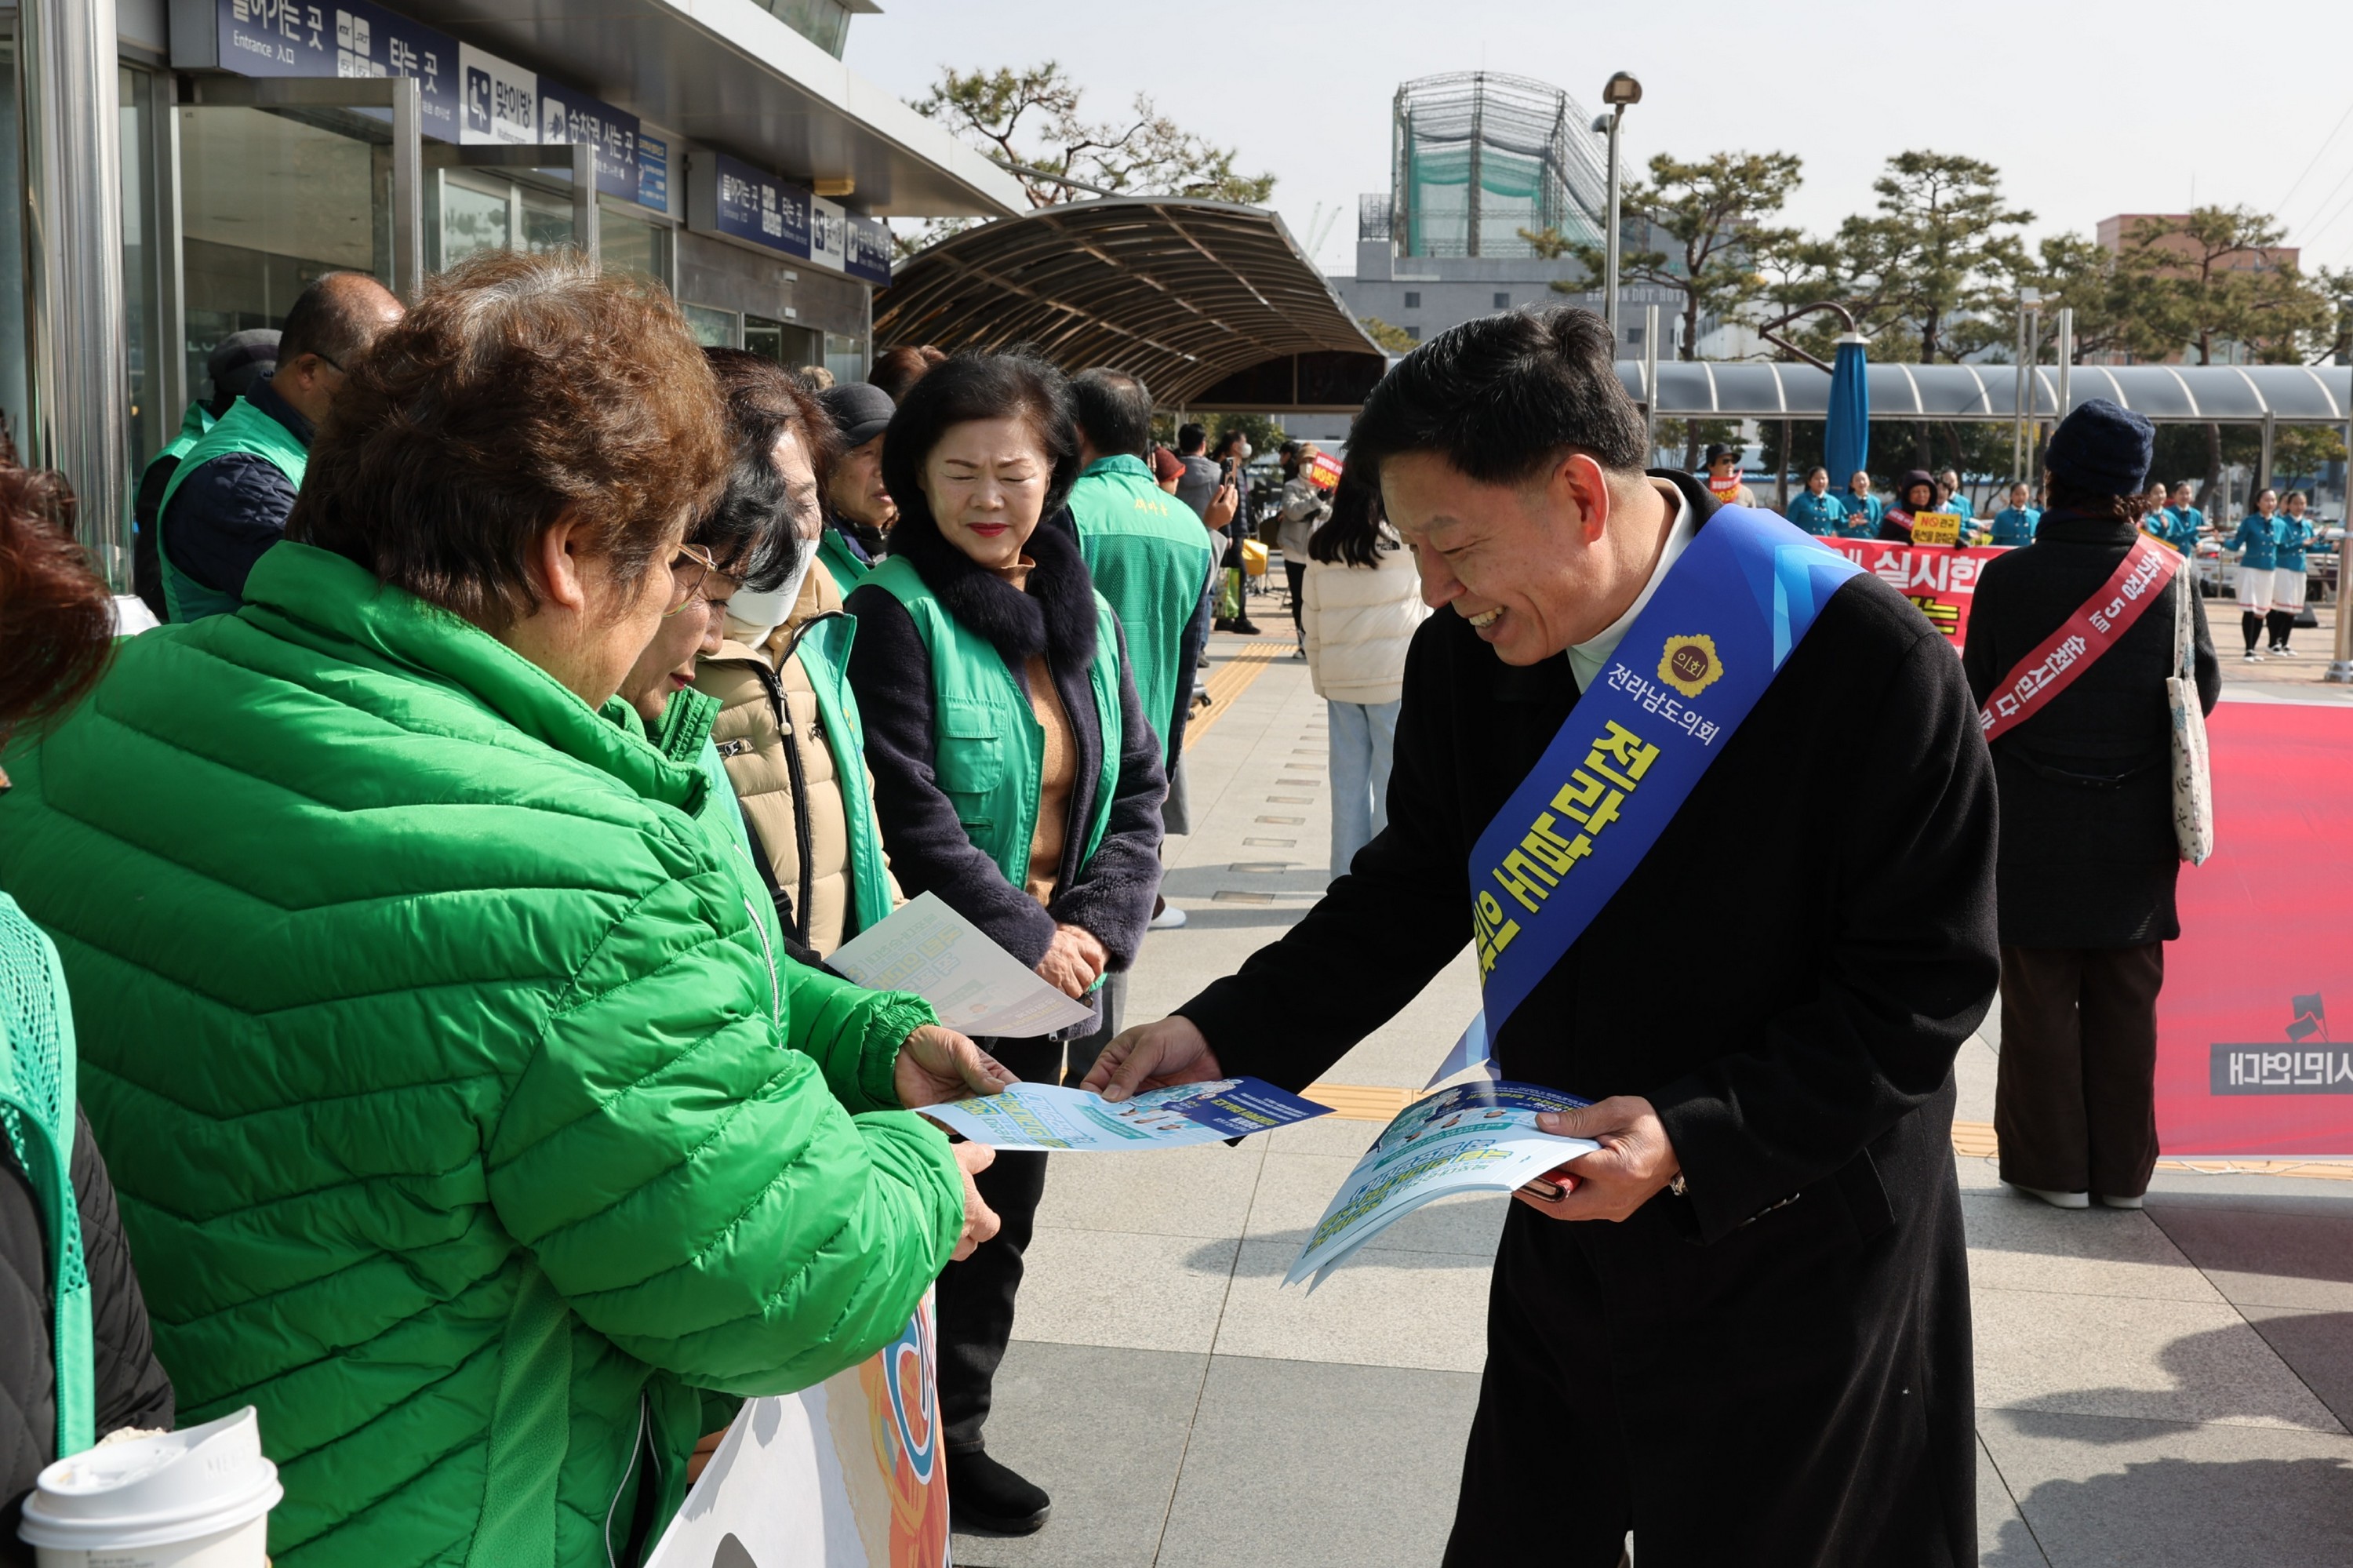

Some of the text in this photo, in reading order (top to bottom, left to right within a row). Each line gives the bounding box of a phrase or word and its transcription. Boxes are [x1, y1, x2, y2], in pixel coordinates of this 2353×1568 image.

[233, 29, 295, 65] Entrance 入口
[307, 5, 323, 51] 곳
[424, 51, 438, 94] 곳
[496, 80, 532, 129] 맞이방
[603, 122, 623, 159] 사는
[625, 131, 634, 166] 곳
[1874, 551, 1986, 595] 실시한
[2122, 548, 2165, 601] 소각장
[2104, 597, 2126, 618] 5
[1672, 653, 1706, 678] 의회
[2014, 634, 2088, 704] 순천시민
[1608, 662, 1720, 746] 전라남도의회
[1995, 693, 2020, 717] 다
[1492, 719, 1660, 915] 전라남도
